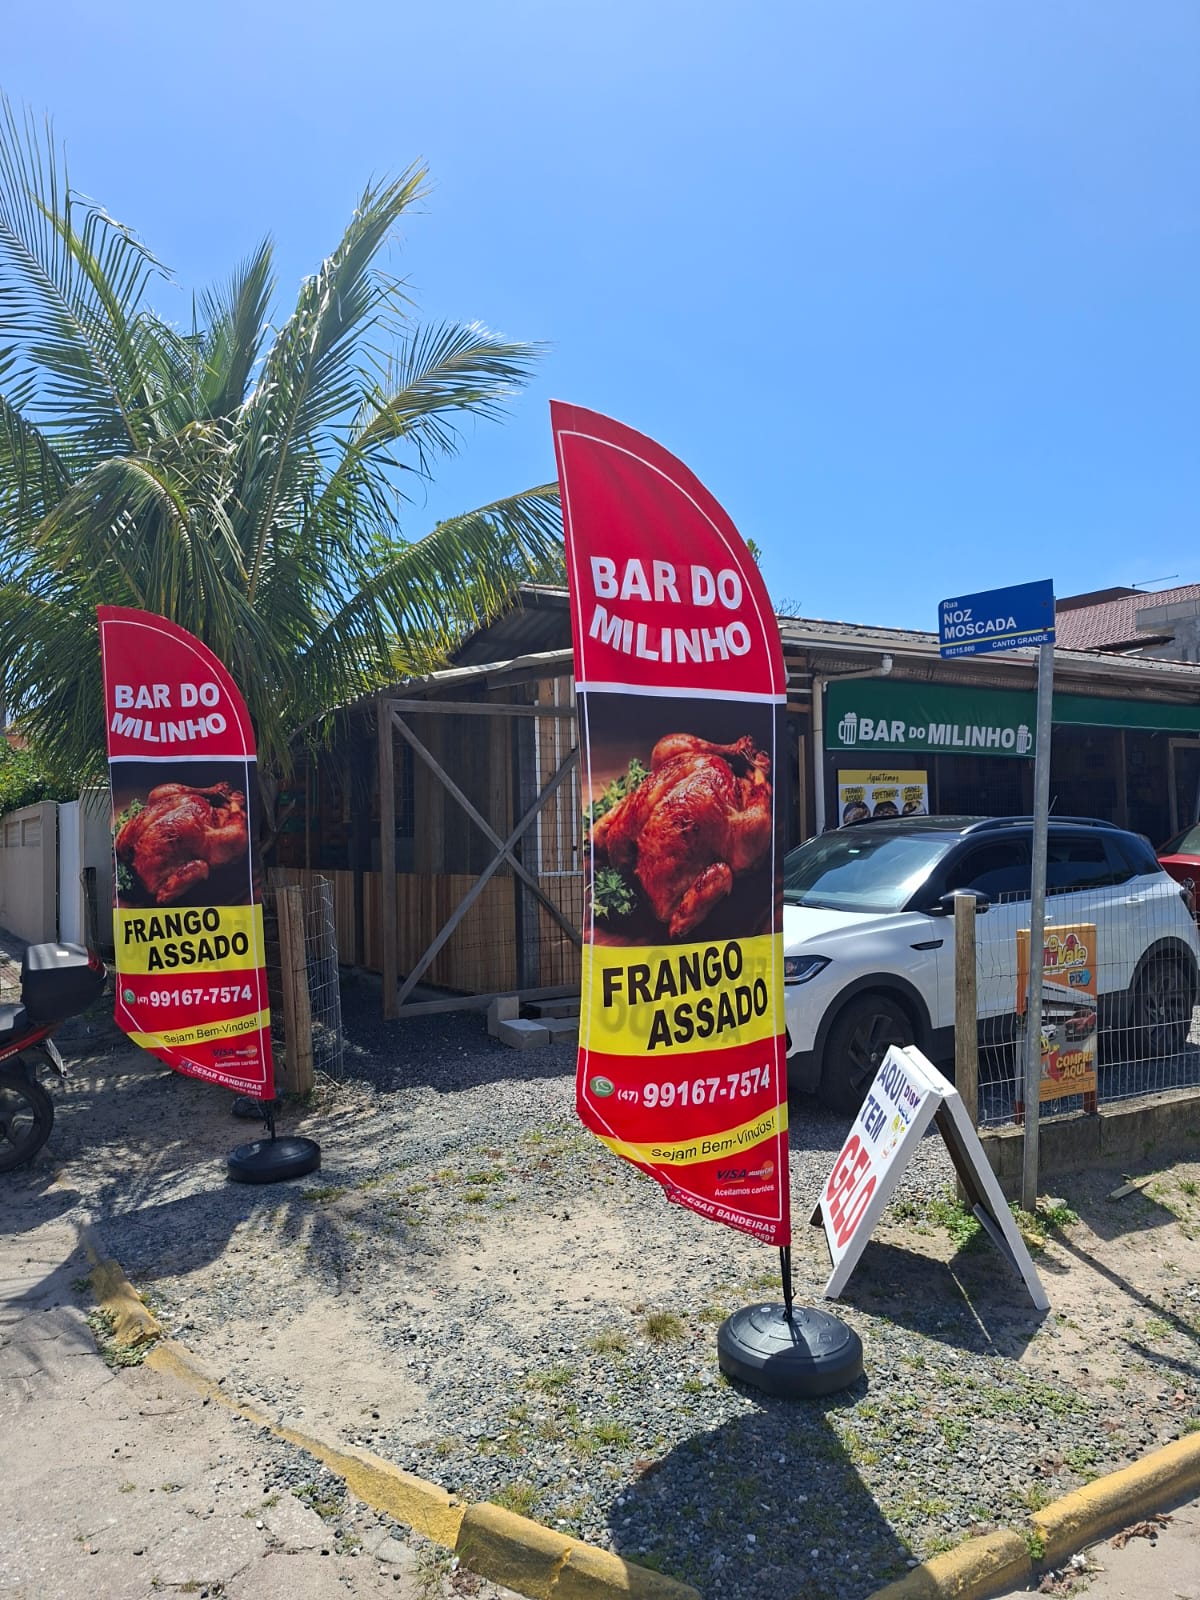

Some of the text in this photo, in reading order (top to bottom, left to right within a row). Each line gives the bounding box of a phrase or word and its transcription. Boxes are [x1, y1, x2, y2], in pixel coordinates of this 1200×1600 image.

[590, 556, 743, 610] BAR DO
[943, 601, 958, 609] Rua
[943, 609, 973, 625] NOZ
[589, 604, 751, 664] MILINHO
[944, 616, 1017, 639] MOSCADA
[992, 638, 1016, 648] CANTO
[1017, 634, 1048, 644] GRANDE
[115, 682, 220, 709] BAR DO
[111, 712, 227, 743] MILINHO
[858, 717, 1015, 748] BAR DO MILINHO
[124, 907, 220, 945] FRANGO
[148, 932, 249, 971] ASSADO
[602, 941, 743, 1008] FRANGO
[149, 984, 252, 1007] 99167-7574
[647, 977, 768, 1050] ASSADO
[163, 1017, 258, 1045] Sejam Bem-Vindos!
[1056, 1051, 1094, 1068] COMPRE
[1062, 1063, 1086, 1080] AQUI
[192, 1065, 217, 1079] CESAR
[218, 1074, 263, 1092] BANDEIRAS
[617, 1064, 770, 1108] (47) 99167-7574
[877, 1057, 907, 1106] AQUI
[860, 1094, 888, 1143] TEM
[651, 1116, 775, 1161] Sejam Bem-Vindos!
[717, 1168, 747, 1180] VISA
[715, 1187, 750, 1197] Aceitamos
[826, 1134, 877, 1249] GELO
[716, 1208, 777, 1233] BANDEIRAS
